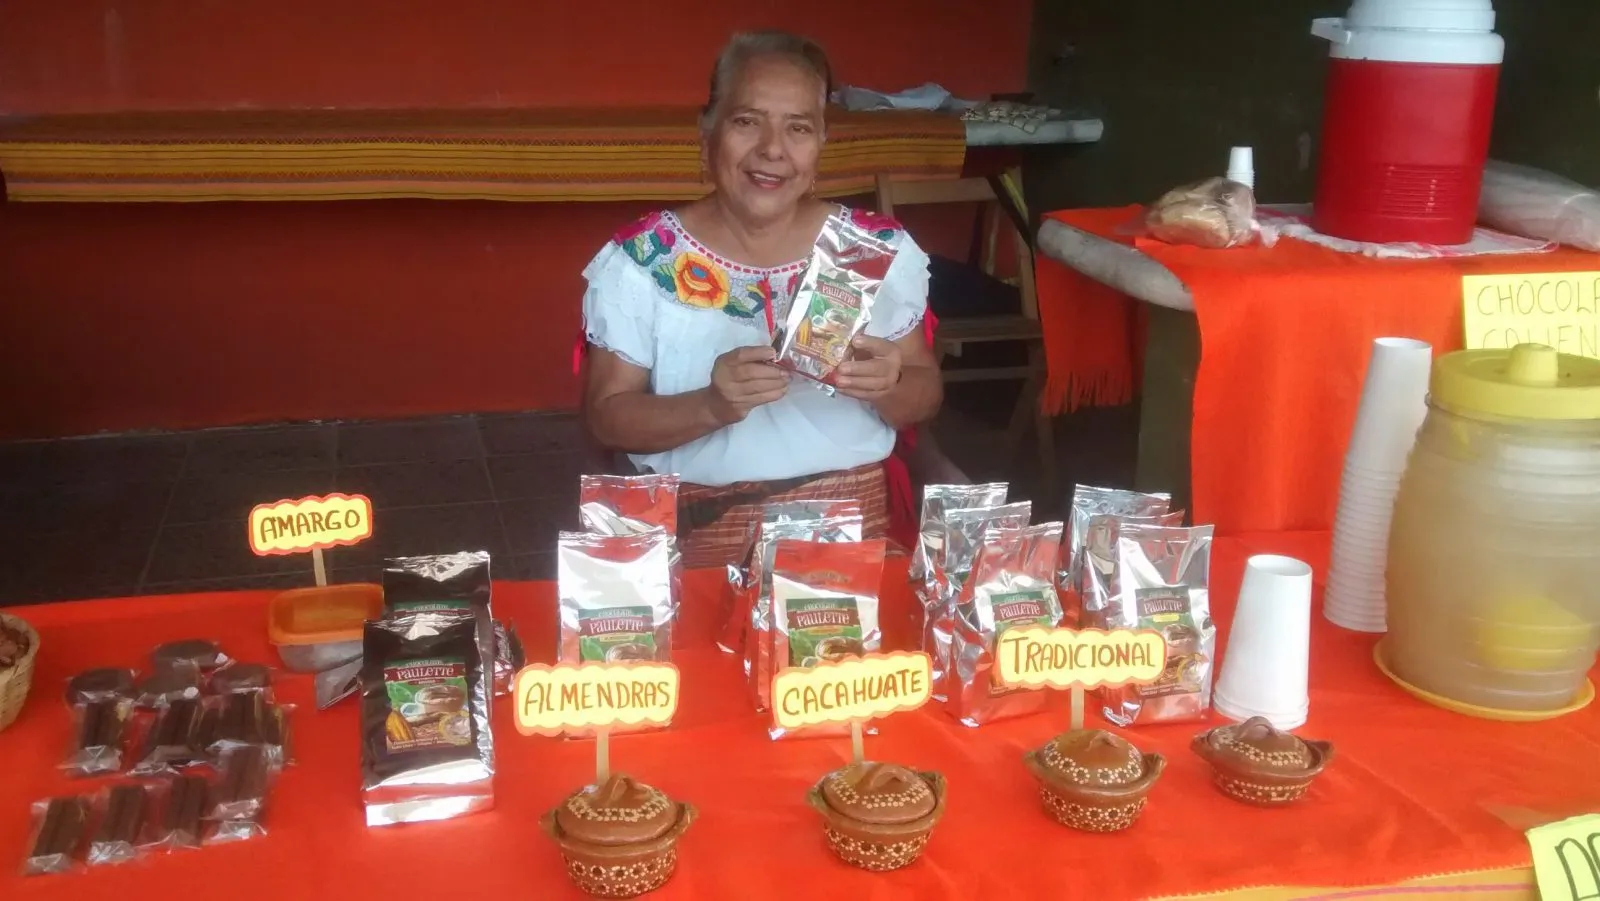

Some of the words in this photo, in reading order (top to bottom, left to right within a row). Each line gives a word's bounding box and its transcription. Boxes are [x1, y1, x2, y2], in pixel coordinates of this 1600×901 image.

[260, 509, 361, 543] AMARGO
[1002, 636, 1157, 674] TRADICIONAL
[524, 681, 671, 716] ALMENDRAS
[782, 669, 923, 715] CACAHUATE
